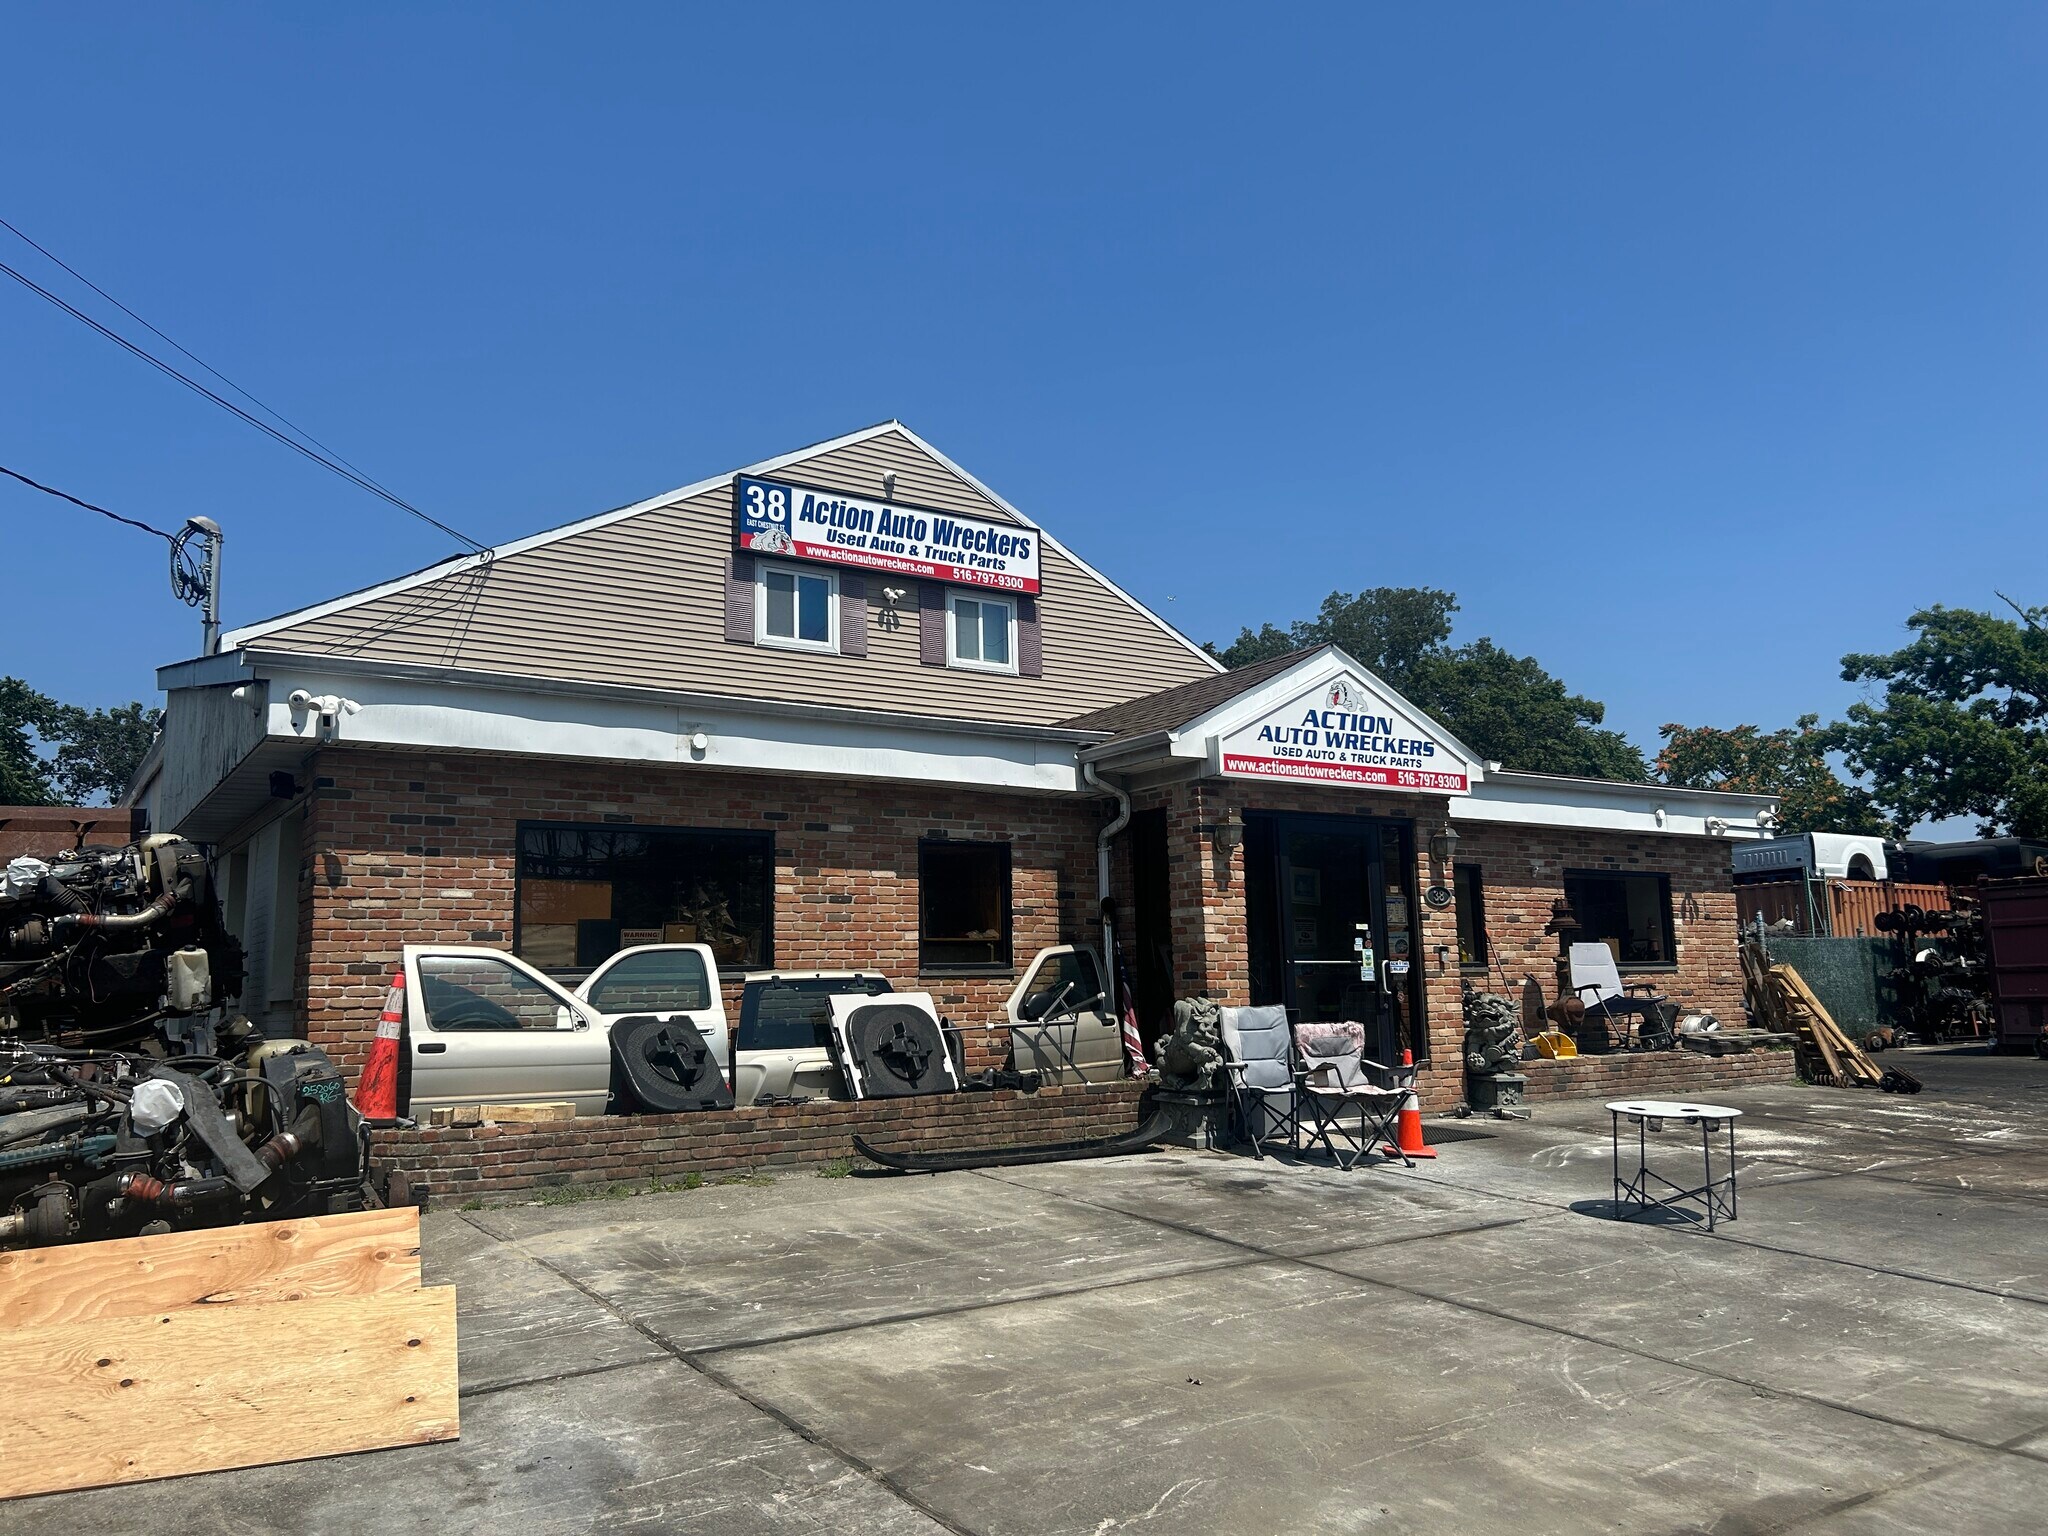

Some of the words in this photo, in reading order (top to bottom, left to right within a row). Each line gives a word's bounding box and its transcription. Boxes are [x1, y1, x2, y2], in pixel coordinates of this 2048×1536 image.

[746, 485, 786, 523] 38
[746, 518, 758, 527] EAST
[799, 494, 874, 533] Action
[877, 508, 927, 542] Auto
[933, 518, 1030, 559] Wreckers
[826, 528, 867, 548] Used
[869, 536, 905, 555] Auto
[908, 544, 920, 557] &
[925, 545, 966, 565] Truck
[968, 553, 1007, 571] Parts
[806, 546, 934, 575] www.actionautowreckers.com
[953, 568, 1023, 588] 516-797-9300
[1301, 709, 1393, 735] ACTION
[1257, 725, 1319, 747] AUTO
[1325, 731, 1435, 758] WRECKERS
[1273, 746, 1303, 758] USED
[1305, 749, 1336, 761] AUTO
[1338, 752, 1347, 762] &
[1350, 753, 1387, 766] TRUCK
[1390, 756, 1422, 769] PARTS
[1227, 759, 1387, 782] www.actionautowreckers.com
[1398, 771, 1461, 789] 516-797-9300
[1433, 890, 1445, 902] 38
